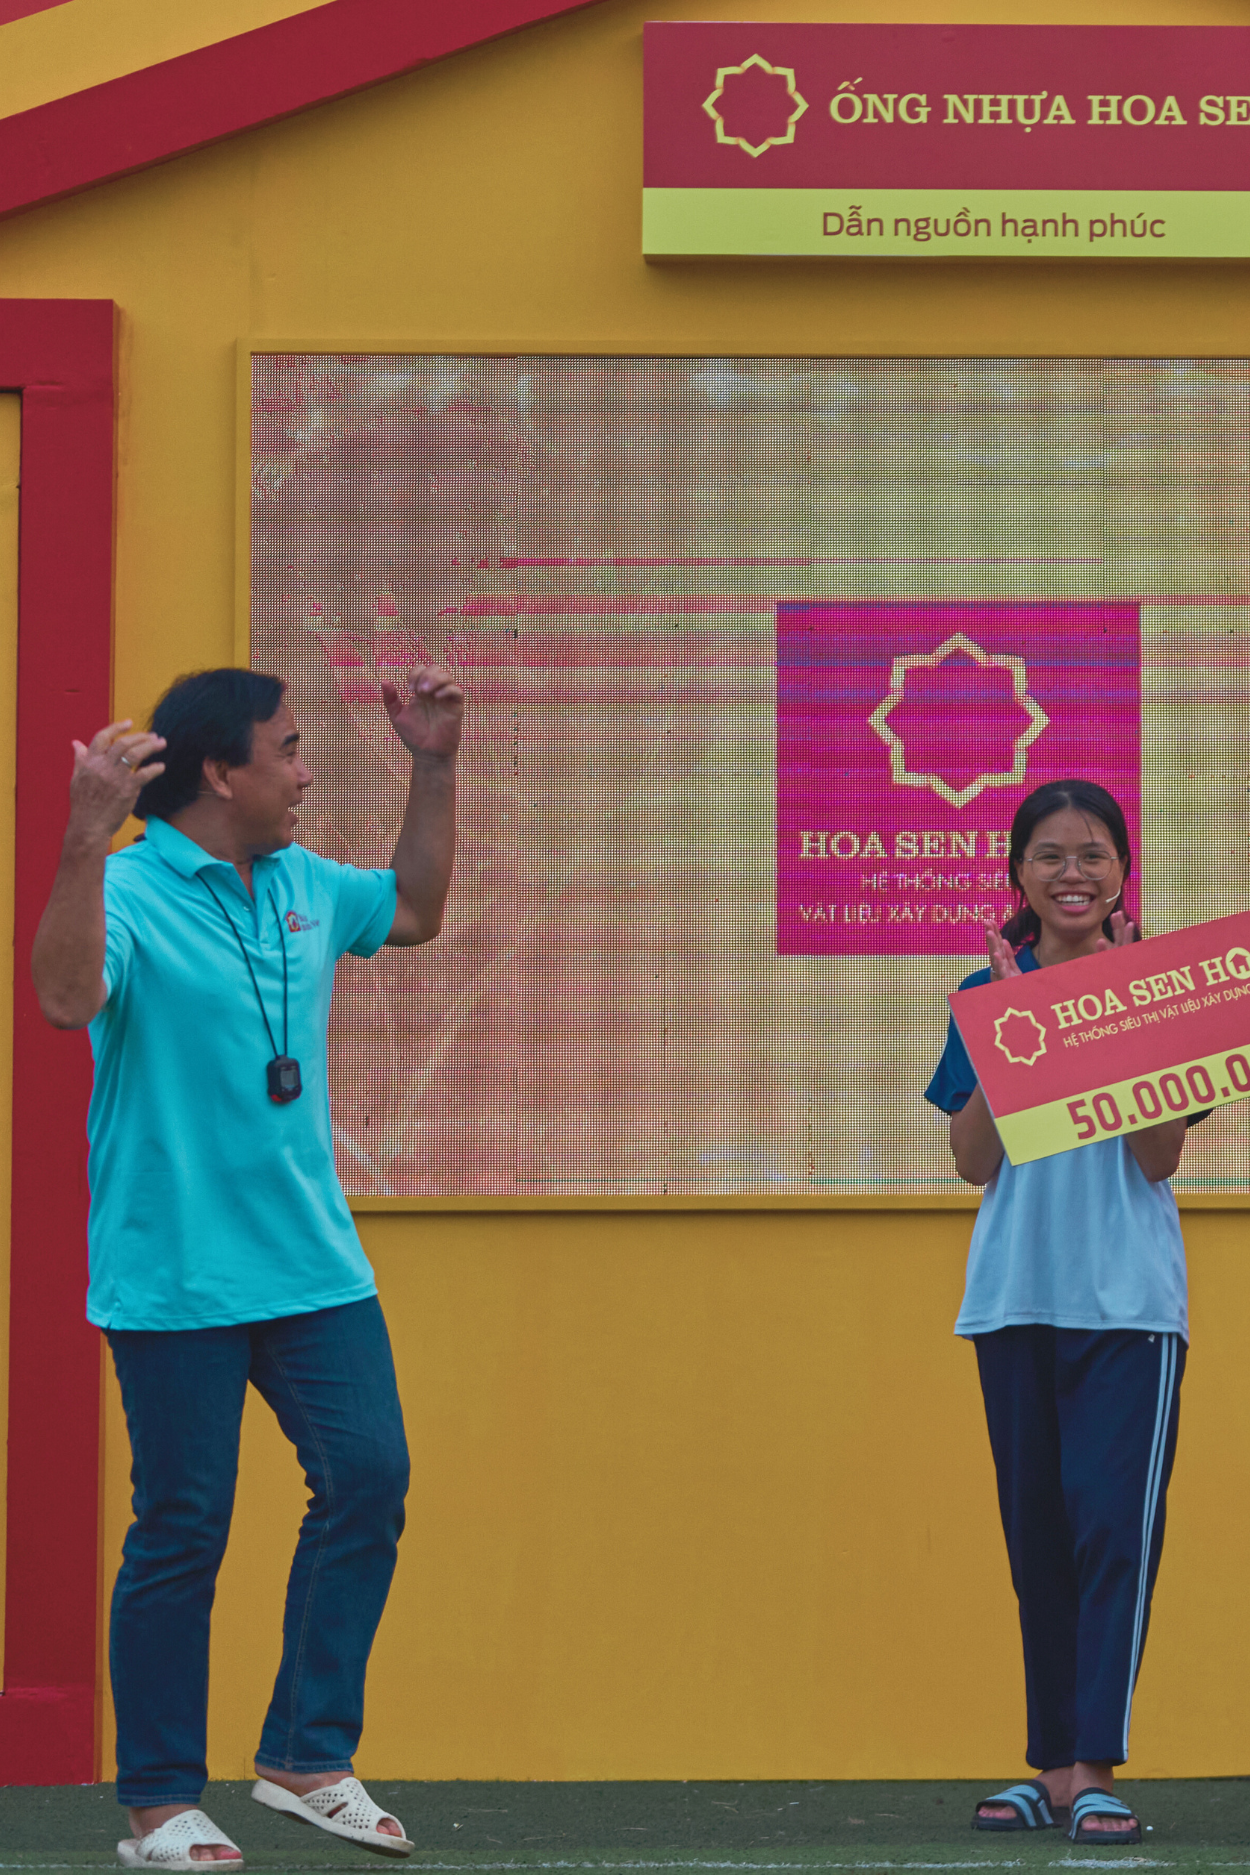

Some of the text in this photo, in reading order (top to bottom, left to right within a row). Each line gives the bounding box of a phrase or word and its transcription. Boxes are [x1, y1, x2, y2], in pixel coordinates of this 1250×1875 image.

[829, 76, 932, 126] ỐNG
[943, 90, 1076, 133] NHỰA
[1087, 95, 1187, 126] HOA
[821, 204, 1166, 243] Dẫn nguồn hạnh phúc
[800, 831, 888, 859] HOA
[895, 831, 979, 859] SEN
[1050, 988, 1128, 1030] HOA
[1128, 965, 1197, 1008] SEN
[1063, 1032, 1080, 1048] HỆ
[1078, 1023, 1119, 1044] THỐNG
[1120, 1015, 1142, 1032] SIÊU
[1142, 1010, 1160, 1024] THỊ
[1159, 1003, 1180, 1020] VẬT
[1181, 997, 1202, 1015] LIỆU
[1202, 991, 1222, 1008] XÂY
